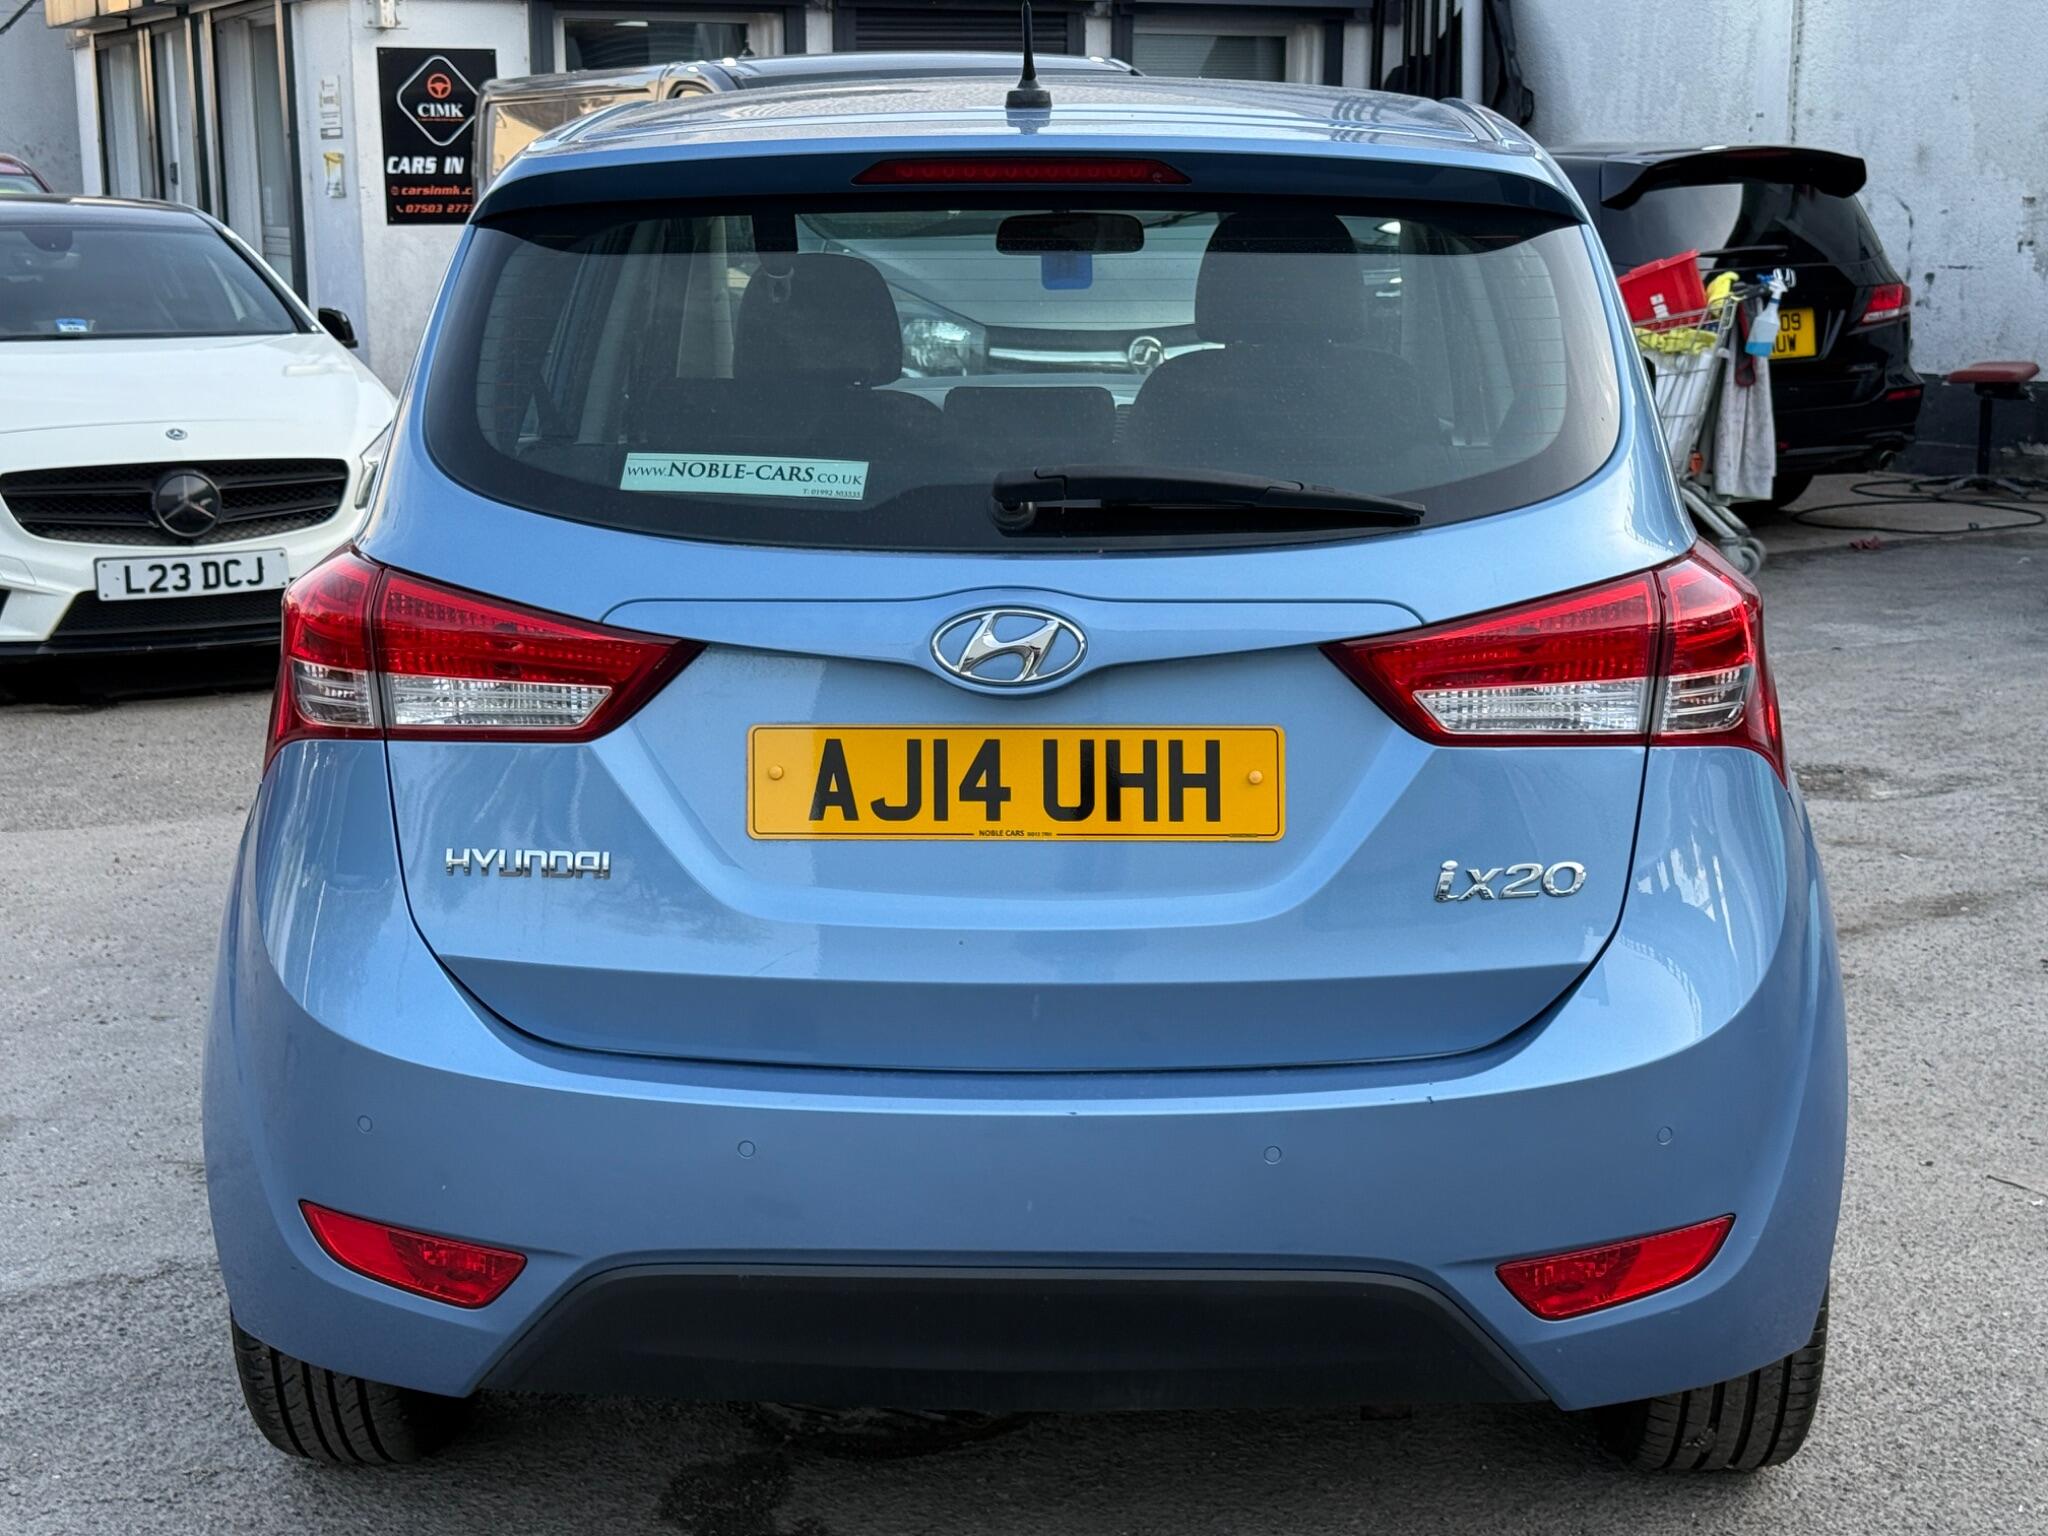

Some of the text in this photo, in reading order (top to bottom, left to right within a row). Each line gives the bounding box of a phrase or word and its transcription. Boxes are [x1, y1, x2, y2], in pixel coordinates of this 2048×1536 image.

[417, 103, 464, 117] CIMK
[387, 156, 465, 174] CARS IN
[405, 204, 443, 213] 07503
[1780, 313, 1801, 331] 09
[1773, 334, 1796, 353] UW
[124, 557, 265, 595] L23 DCJ
[808, 738, 1222, 823] AJ14 UHH
[445, 847, 611, 879] HYUNDAI
[1434, 860, 1588, 902] ix20
